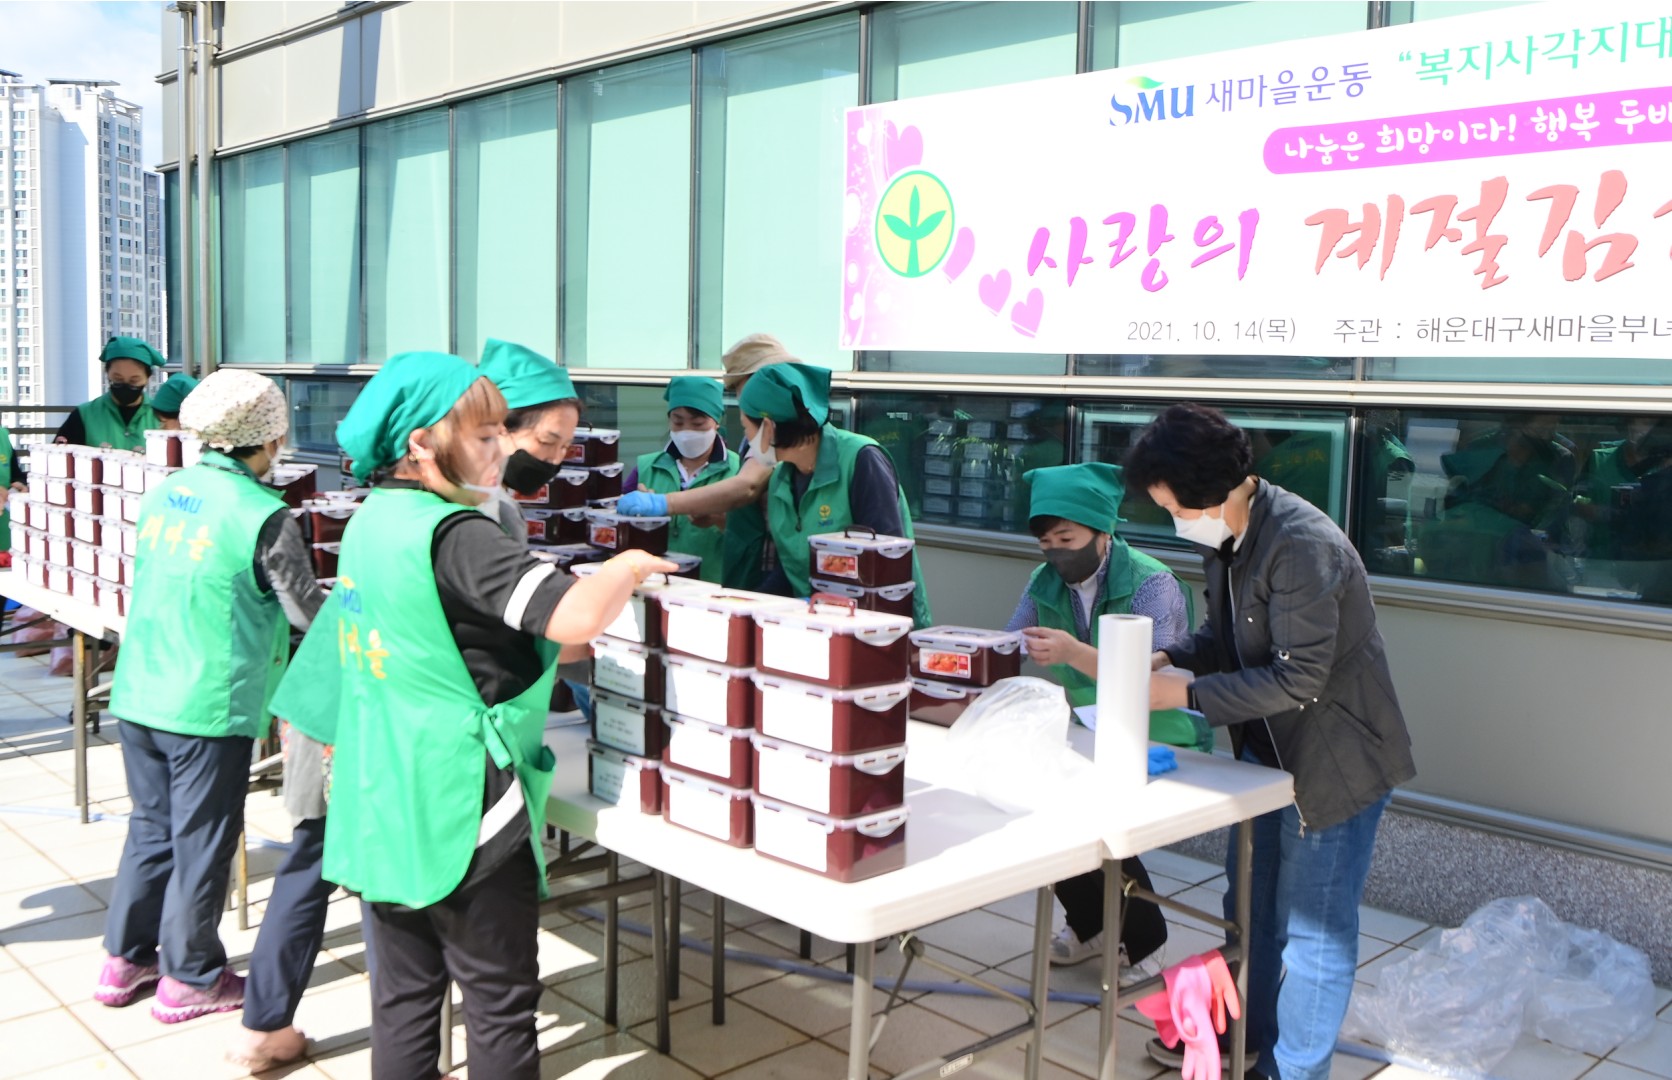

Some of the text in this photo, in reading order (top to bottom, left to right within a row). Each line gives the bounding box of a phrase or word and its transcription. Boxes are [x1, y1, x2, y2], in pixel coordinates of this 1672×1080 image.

[1109, 84, 1195, 127] SMU
[1205, 62, 1372, 112] 새마을운동
[1284, 131, 1366, 166] 나눔은
[1376, 113, 1517, 155] 희망이다!
[1530, 101, 1600, 142] 행복
[1027, 169, 1672, 293] 사랑의 계절김
[1127, 318, 1296, 343] 2021. 10. 14(목)
[1333, 318, 1382, 343] 주관
[338, 617, 390, 679] 마을
